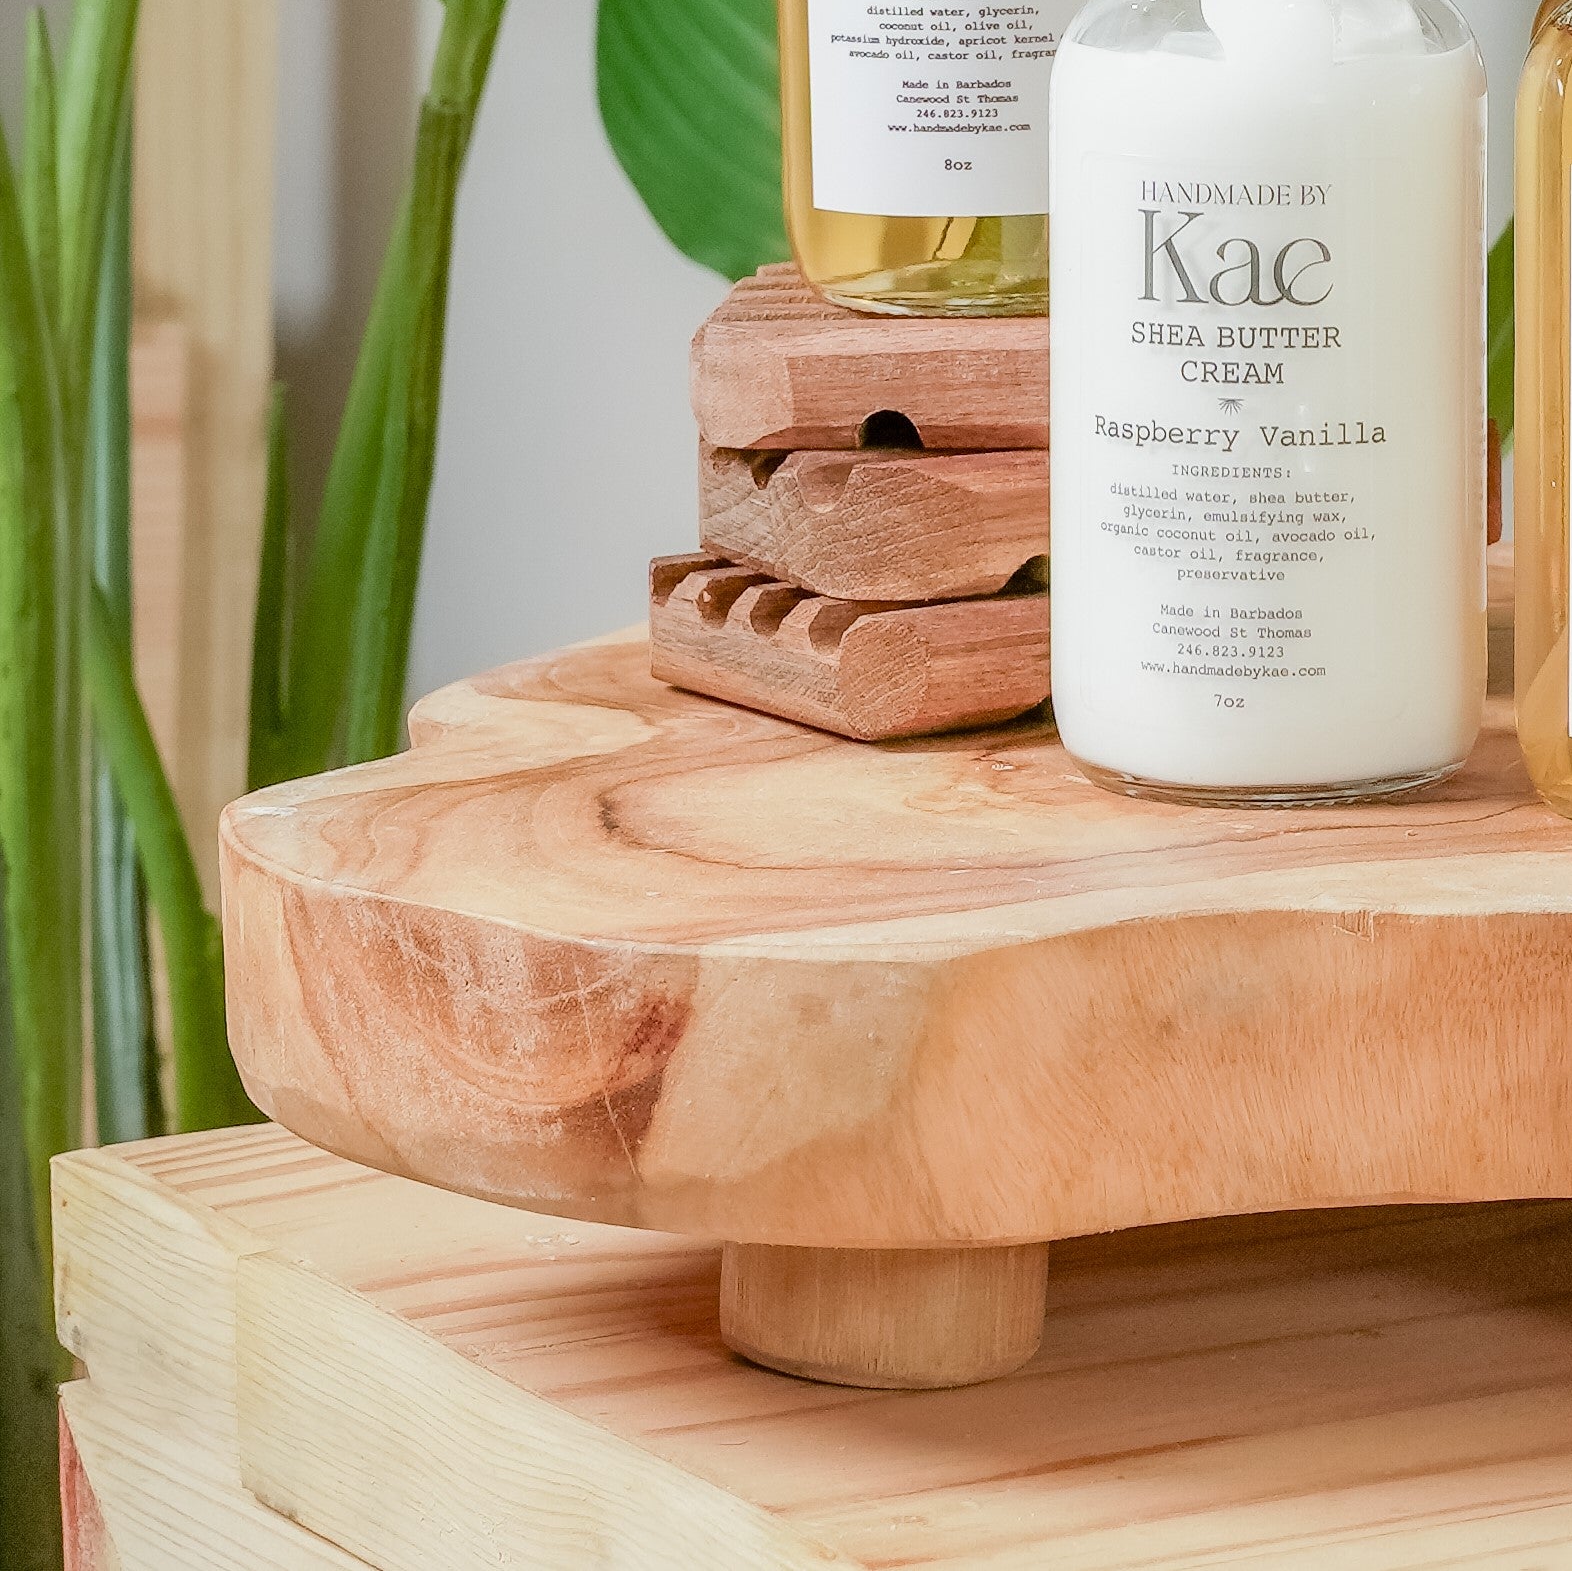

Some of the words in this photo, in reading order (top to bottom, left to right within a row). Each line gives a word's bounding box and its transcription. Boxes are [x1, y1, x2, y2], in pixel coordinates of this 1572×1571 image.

[866, 5, 924, 17] distilled
[929, 7, 970, 18] water,
[978, 4, 1040, 19] glycerin,
[878, 22, 925, 31] coconut
[929, 20, 957, 33] oil,
[964, 20, 1001, 31] olive
[1006, 19, 1033, 31] oil,
[916, 108, 999, 119] 246.823.9123
[944, 158, 973, 171] 8oz
[1142, 180, 1291, 206] HANDMADE
[1300, 184, 1332, 206] BY
[1137, 208, 1334, 307] Kae
[1131, 321, 1206, 348] SHEA
[1216, 325, 1342, 350] BUTTER
[1180, 359, 1285, 385] CREAM
[1094, 414, 1241, 453] Raspberry
[1259, 421, 1387, 447] Vanilla
[1172, 463, 1291, 479] INGREDIENTS:
[1110, 483, 1178, 502] distilled
[1185, 490, 1237, 506] water,
[1249, 491, 1287, 505] shea
[1294, 490, 1355, 506] butter,
[1123, 502, 1192, 525] glycerin,
[1203, 509, 1305, 527] emulsifying
[1312, 511, 1346, 524] wax,
[1100, 519, 1150, 538] organic
[1156, 528, 1217, 542] coconut
[1225, 528, 1260, 545] oil,
[1271, 528, 1336, 543] avocado
[1343, 526, 1375, 542] oil,
[1133, 545, 1182, 560] castor
[1189, 546, 1223, 564] oil,
[1235, 548, 1324, 566] fragrance,
[1176, 566, 1286, 581] preservative
[1160, 603, 1194, 620] Made
[1203, 605, 1222, 620] in
[1229, 606, 1303, 621] Barbados
[1152, 622, 1221, 639] Canewood
[1229, 626, 1248, 639] St
[1256, 625, 1312, 640] Thomas
[1177, 642, 1284, 660] 246.823.9123
[1140, 659, 1327, 681] www.handmadebykae.com
[1213, 693, 1245, 709] 7oz
